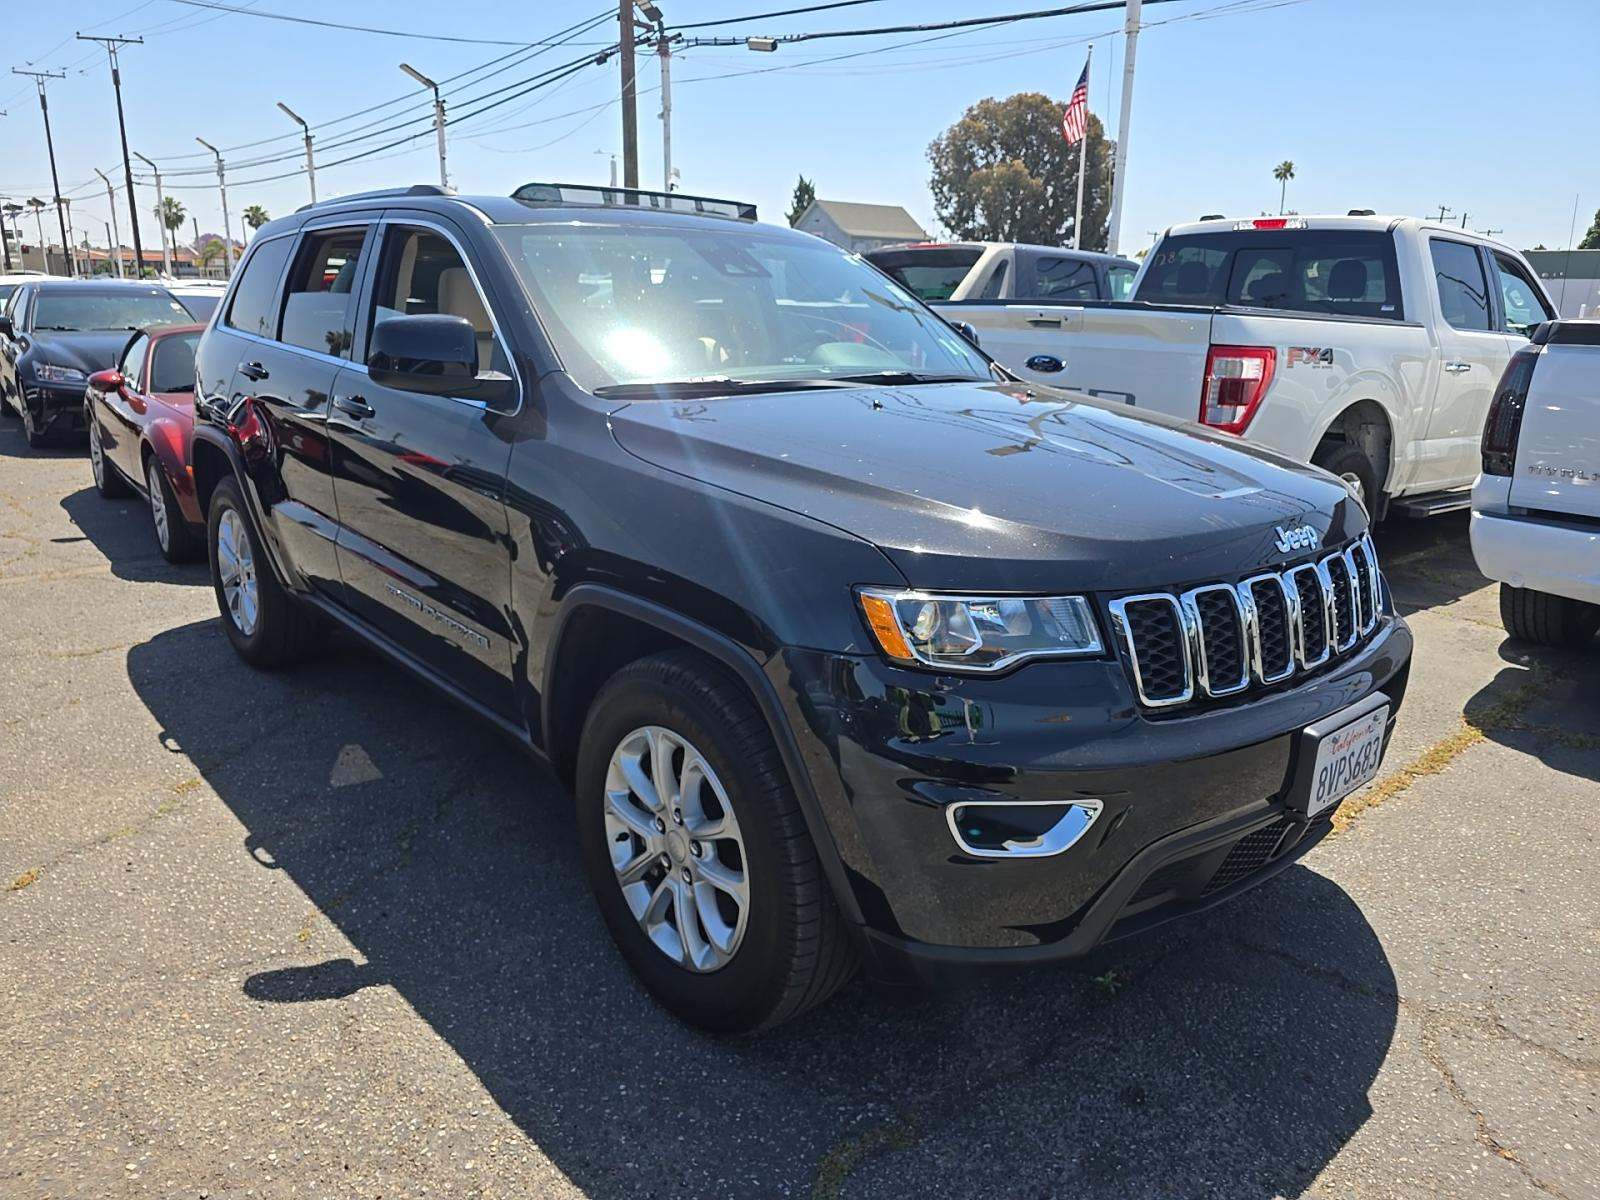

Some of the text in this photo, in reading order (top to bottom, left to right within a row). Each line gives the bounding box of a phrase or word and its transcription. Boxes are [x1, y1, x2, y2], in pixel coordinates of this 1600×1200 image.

[1287, 346, 1333, 368] FX4
[1274, 525, 1318, 553] Jeep
[1316, 736, 1380, 802] 8VPS683
